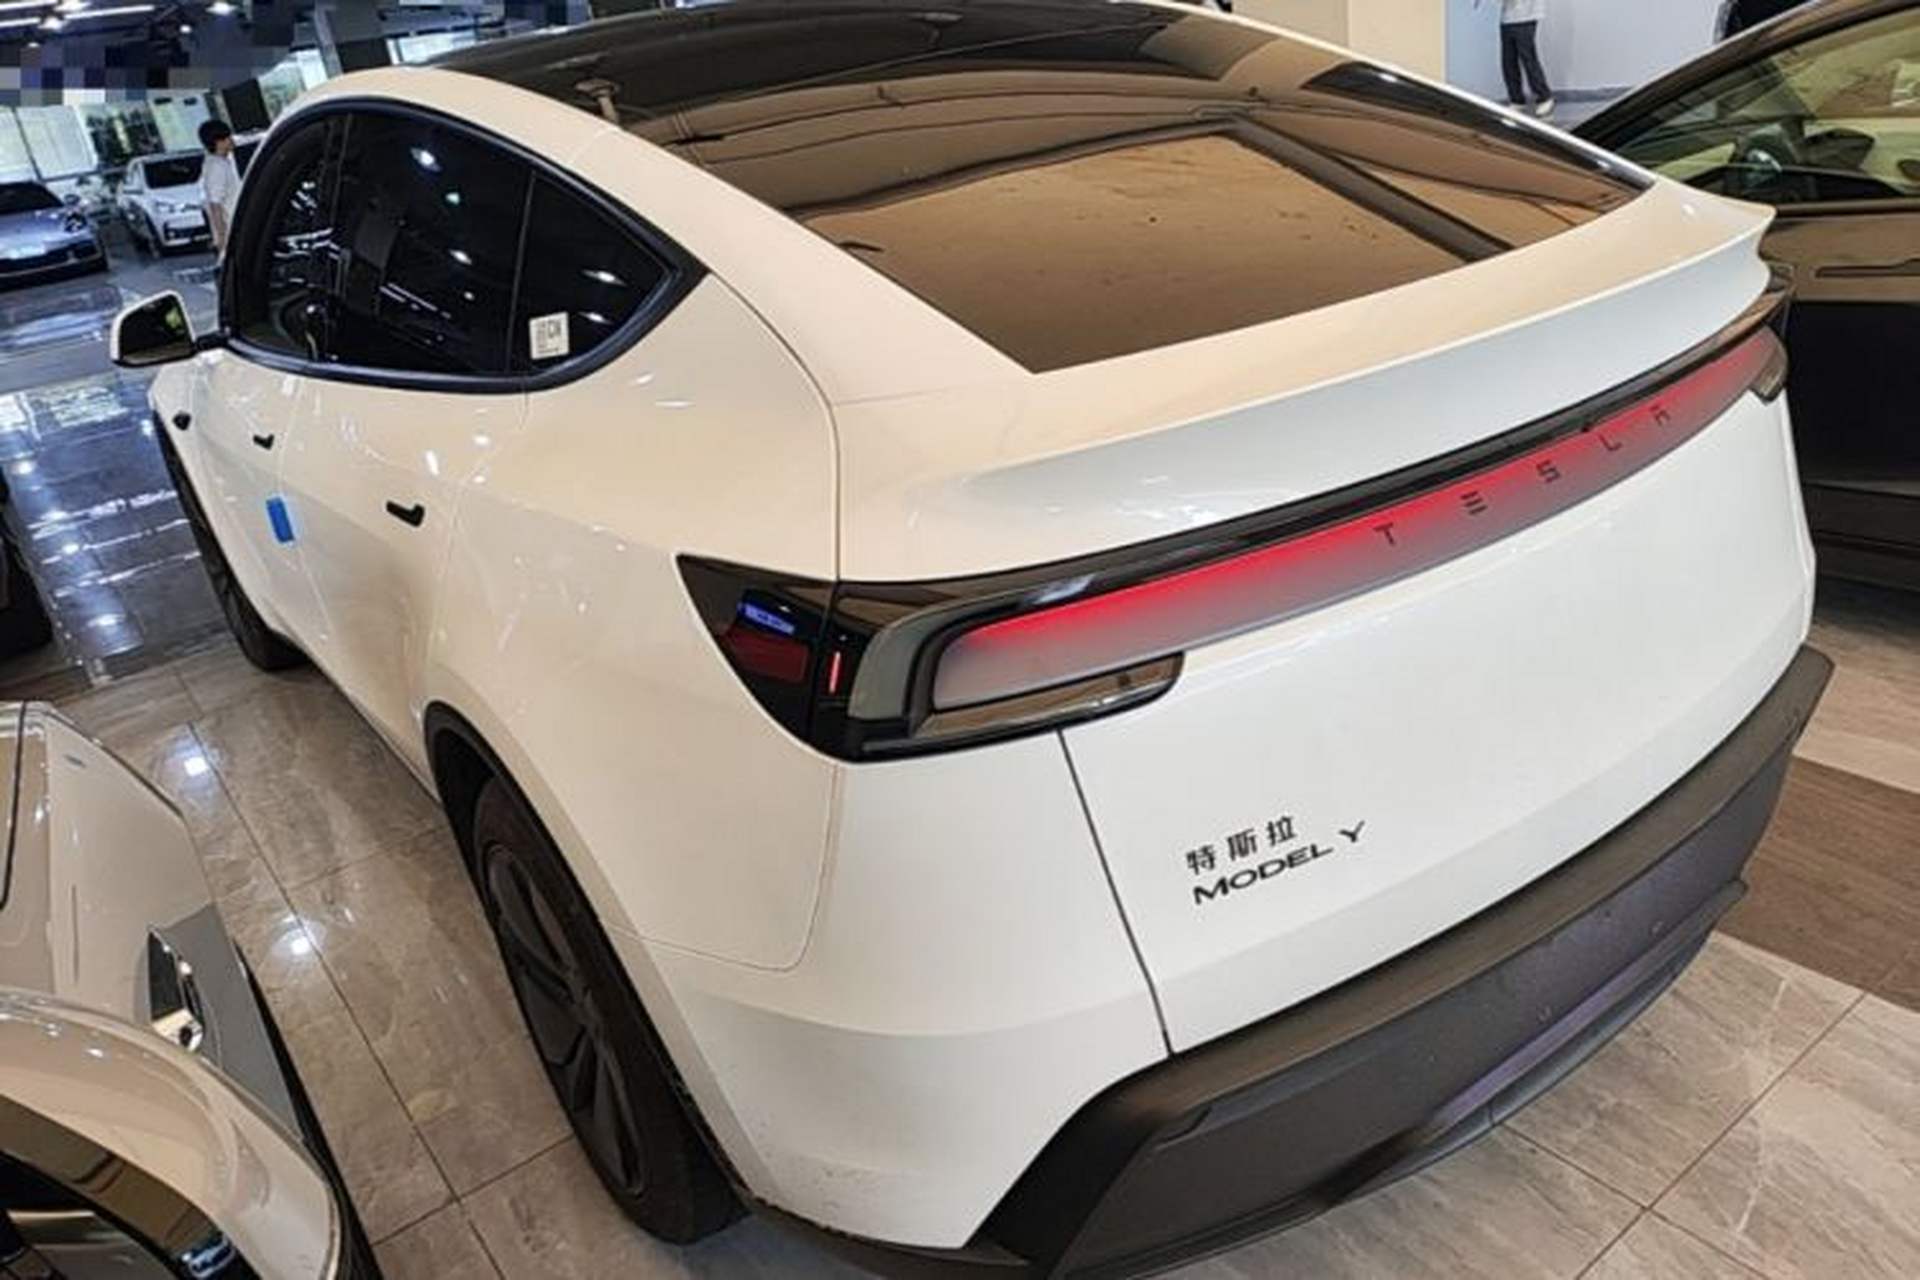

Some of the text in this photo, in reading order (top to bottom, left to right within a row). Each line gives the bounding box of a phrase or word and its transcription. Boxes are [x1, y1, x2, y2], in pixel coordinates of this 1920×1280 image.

[1373, 404, 1670, 545] TESLA
[1186, 816, 1297, 875] 特斯拉
[1193, 820, 1365, 904] MODEL Y
